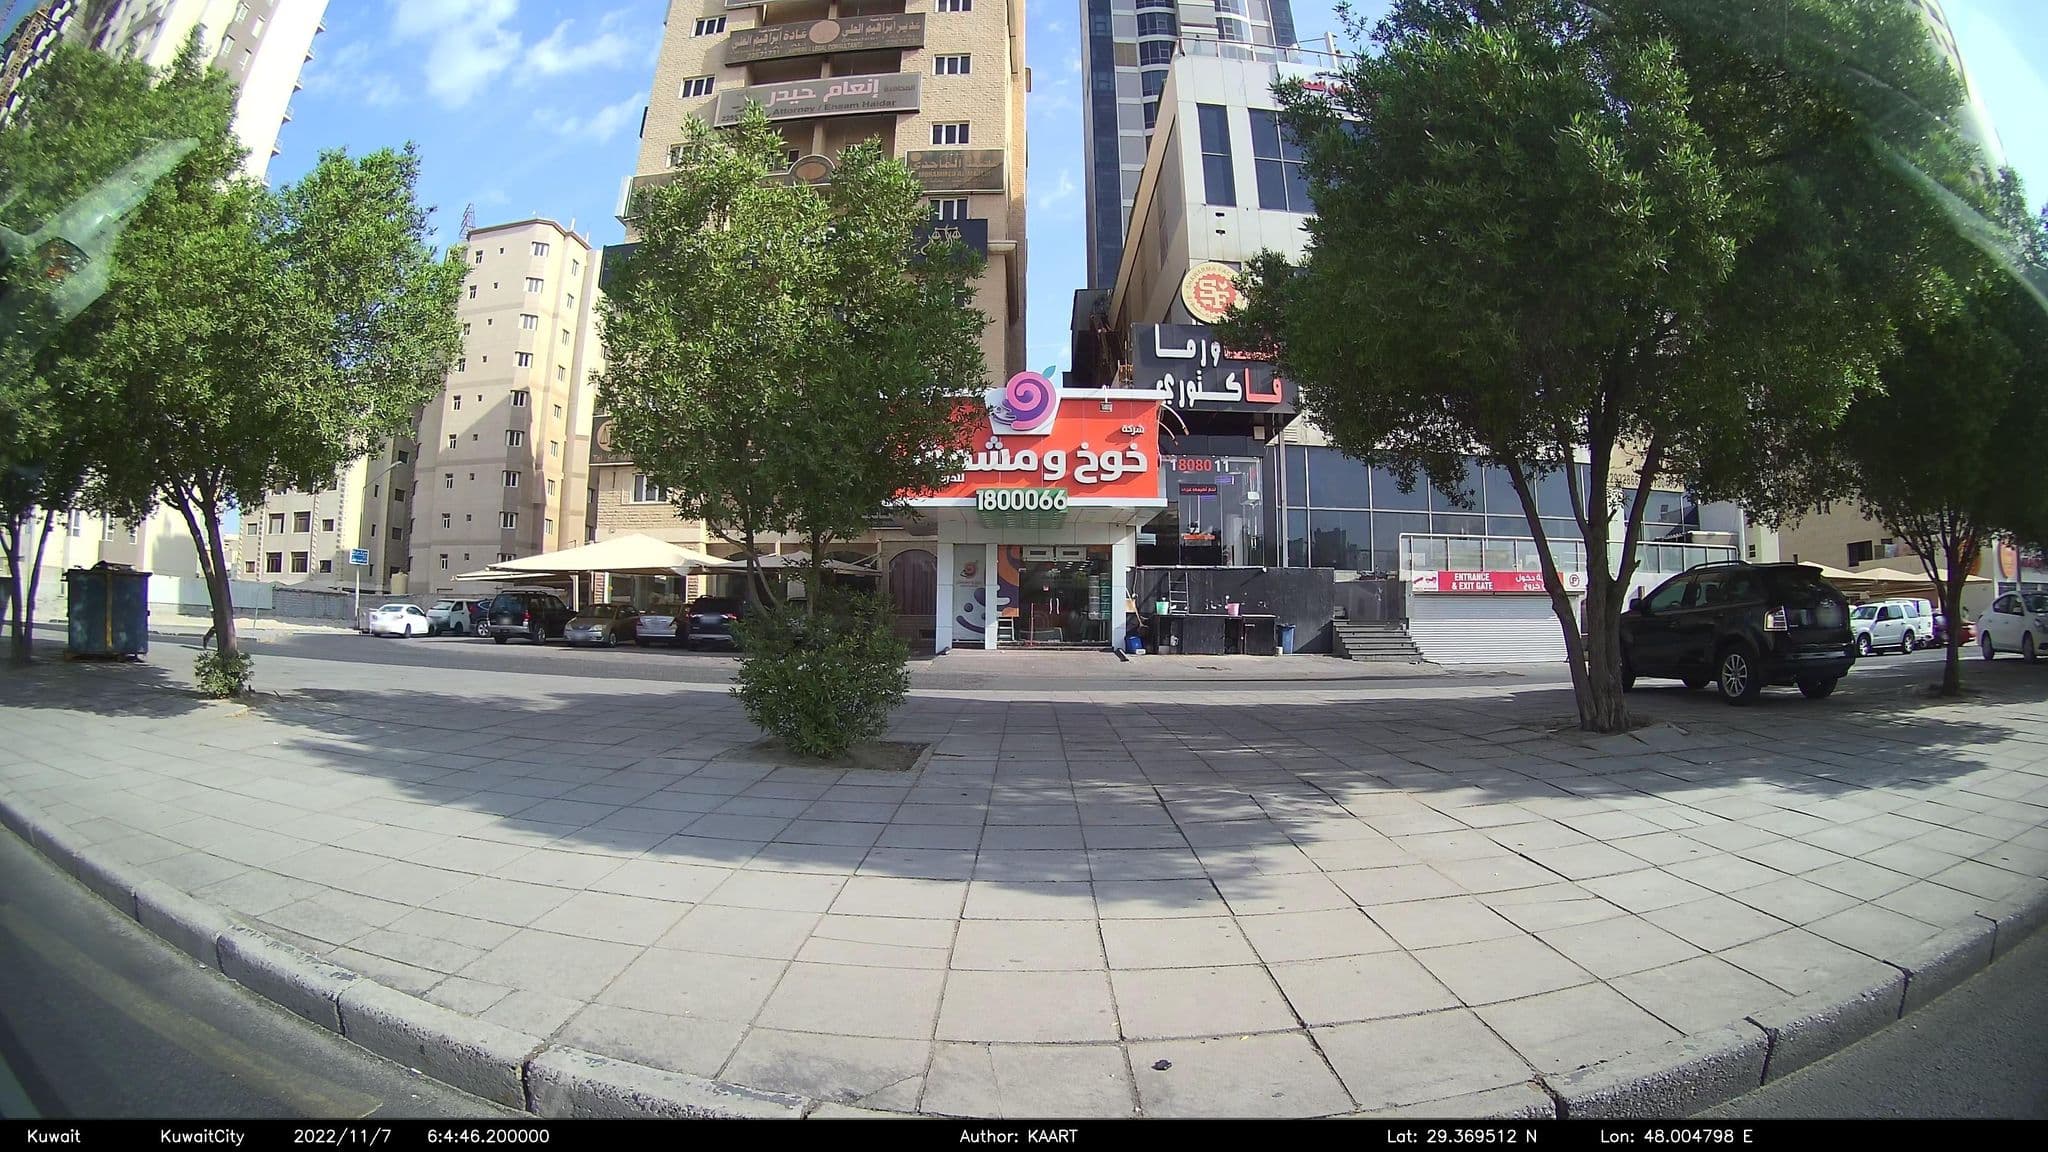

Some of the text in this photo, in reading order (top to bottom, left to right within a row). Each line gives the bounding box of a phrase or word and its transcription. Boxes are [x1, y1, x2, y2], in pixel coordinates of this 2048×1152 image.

[765, 87, 816, 108] حيدر
[823, 79, 879, 103] إنعام
[1043, 449, 1067, 482] و
[1074, 441, 1148, 485] خوخ
[976, 489, 1068, 511] 1800066
[1454, 573, 1490, 581] ENTRANCE
[1459, 582, 1475, 590] EXIT
[1477, 582, 1494, 590] GATE
